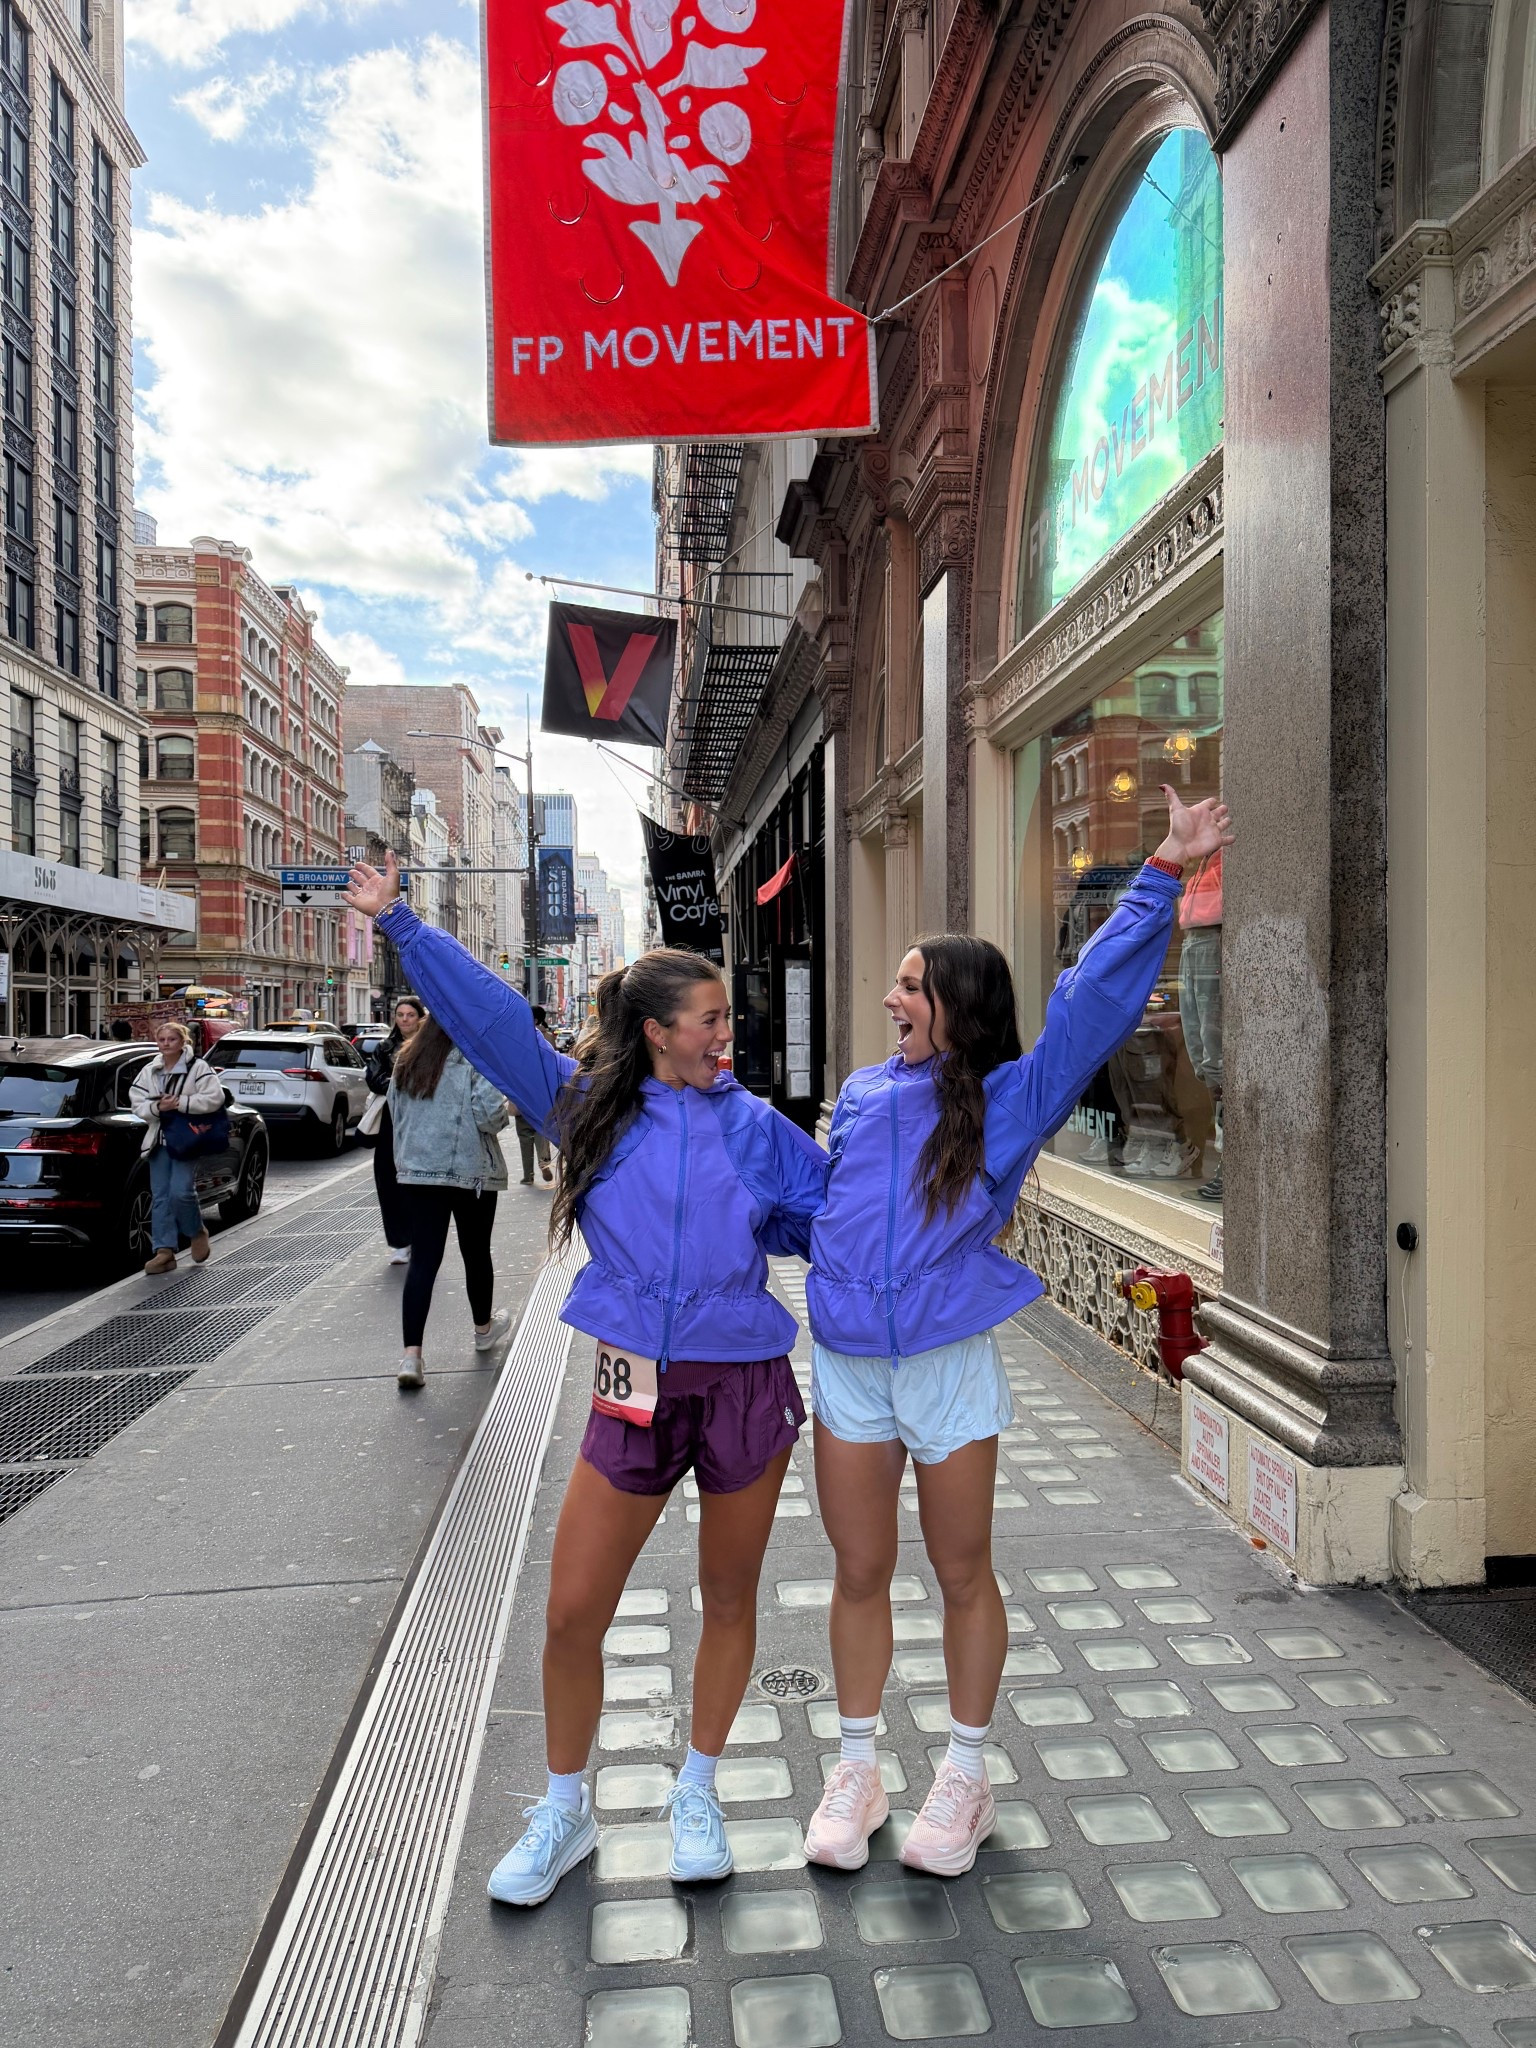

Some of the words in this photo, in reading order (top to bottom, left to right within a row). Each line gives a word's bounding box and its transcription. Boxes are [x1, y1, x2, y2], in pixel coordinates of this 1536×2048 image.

[511, 336, 564, 376] FP
[583, 317, 855, 371] MOVEMENT
[34, 866, 57, 891] 568
[298, 873, 346, 882] BROADWAY
[676, 869, 706, 881] SAMRA
[658, 879, 705, 904] Vinyl
[670, 896, 719, 926] Café
[594, 1347, 633, 1401] 68
[1193, 1404, 1224, 1438] COMBINATION
[1202, 1428, 1214, 1448] AUTO
[1196, 1439, 1221, 1470] SPRINKLER
[1250, 1444, 1271, 1473] AUTOMATIC
[1271, 1459, 1293, 1488] SPRINKLER
[1191, 1452, 1200, 1469] AND
[1201, 1460, 1225, 1492] STANDPIPE
[1256, 1467, 1266, 1486] SHUT
[1266, 1475, 1274, 1493] OFF
[1274, 1481, 1287, 1504] VALVE
[1254, 1485, 1271, 1512] LOCATED
[1253, 1504, 1271, 1531] OPPOSITE
[1271, 1519, 1280, 1539] THIS
[1280, 1526, 1290, 1547] SIGN
[766, 1678, 816, 1689] WATER
